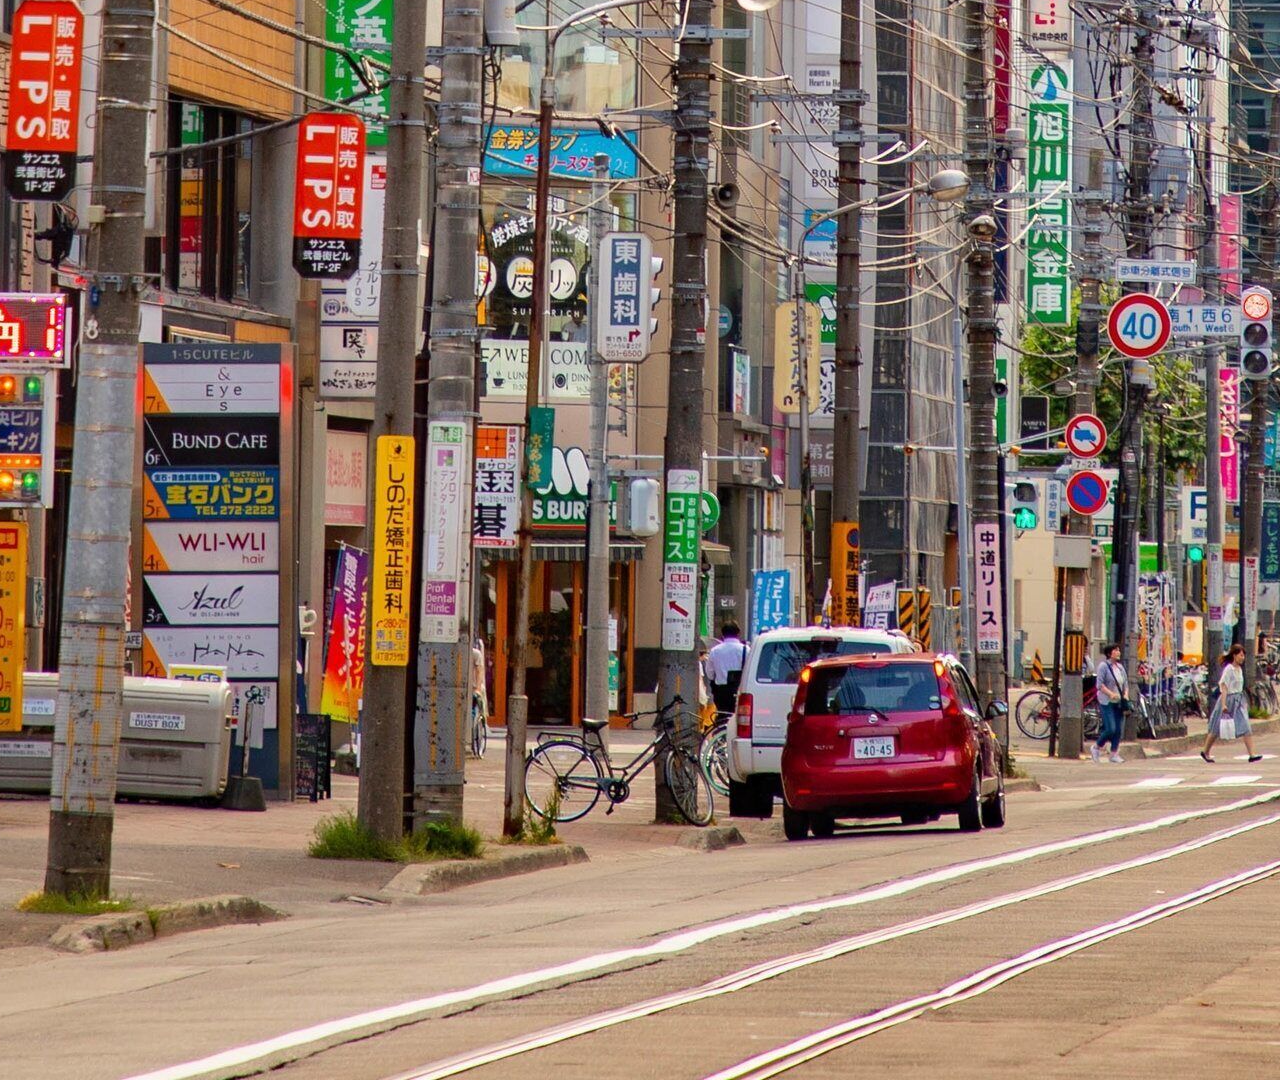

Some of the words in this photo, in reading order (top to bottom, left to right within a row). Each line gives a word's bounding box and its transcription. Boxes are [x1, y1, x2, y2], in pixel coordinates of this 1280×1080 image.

[16, 15, 52, 140] LIPS
[52, 16, 77, 141] 販売・買取
[490, 129, 580, 151] 金券シップ
[23, 153, 61, 166] サンエス
[303, 124, 335, 228] LIPS
[337, 126, 360, 230] 販売・買取
[1030, 109, 1066, 316] 旭川信用金庫
[308, 238, 347, 251] サンエス
[613, 240, 639, 324] 東歯科
[1122, 311, 1157, 340] 40
[1169, 324, 1192, 333] outh
[1205, 324, 1227, 333] West
[218, 366, 231, 381] &
[145, 396, 162, 411] 7F
[172, 433, 221, 449] BUND
[225, 432, 268, 449] CAFE
[145, 448, 161, 465] 6F
[1075, 460, 1097, 468] 7-22
[475, 471, 514, 493] 未来
[166, 484, 275, 505] 宝石バンク
[145, 499, 162, 516] 5F
[195, 505, 218, 515] TEL
[220, 505, 276, 515] 272-2222
[474, 503, 507, 537] 碁
[667, 497, 685, 559] ロゴス
[383, 463, 405, 614] しのだ矯正歯科
[144, 554, 160, 570] 4F
[241, 553, 265, 565] hair
[979, 530, 998, 626] 中道リース
[426, 583, 444, 593] Prof
[426, 593, 456, 603] Dental
[145, 608, 162, 622] 3F
[426, 603, 450, 614] Clinic
[144, 660, 160, 677] 2F
[134, 719, 159, 729] DUST
[161, 720, 180, 729] BOX
